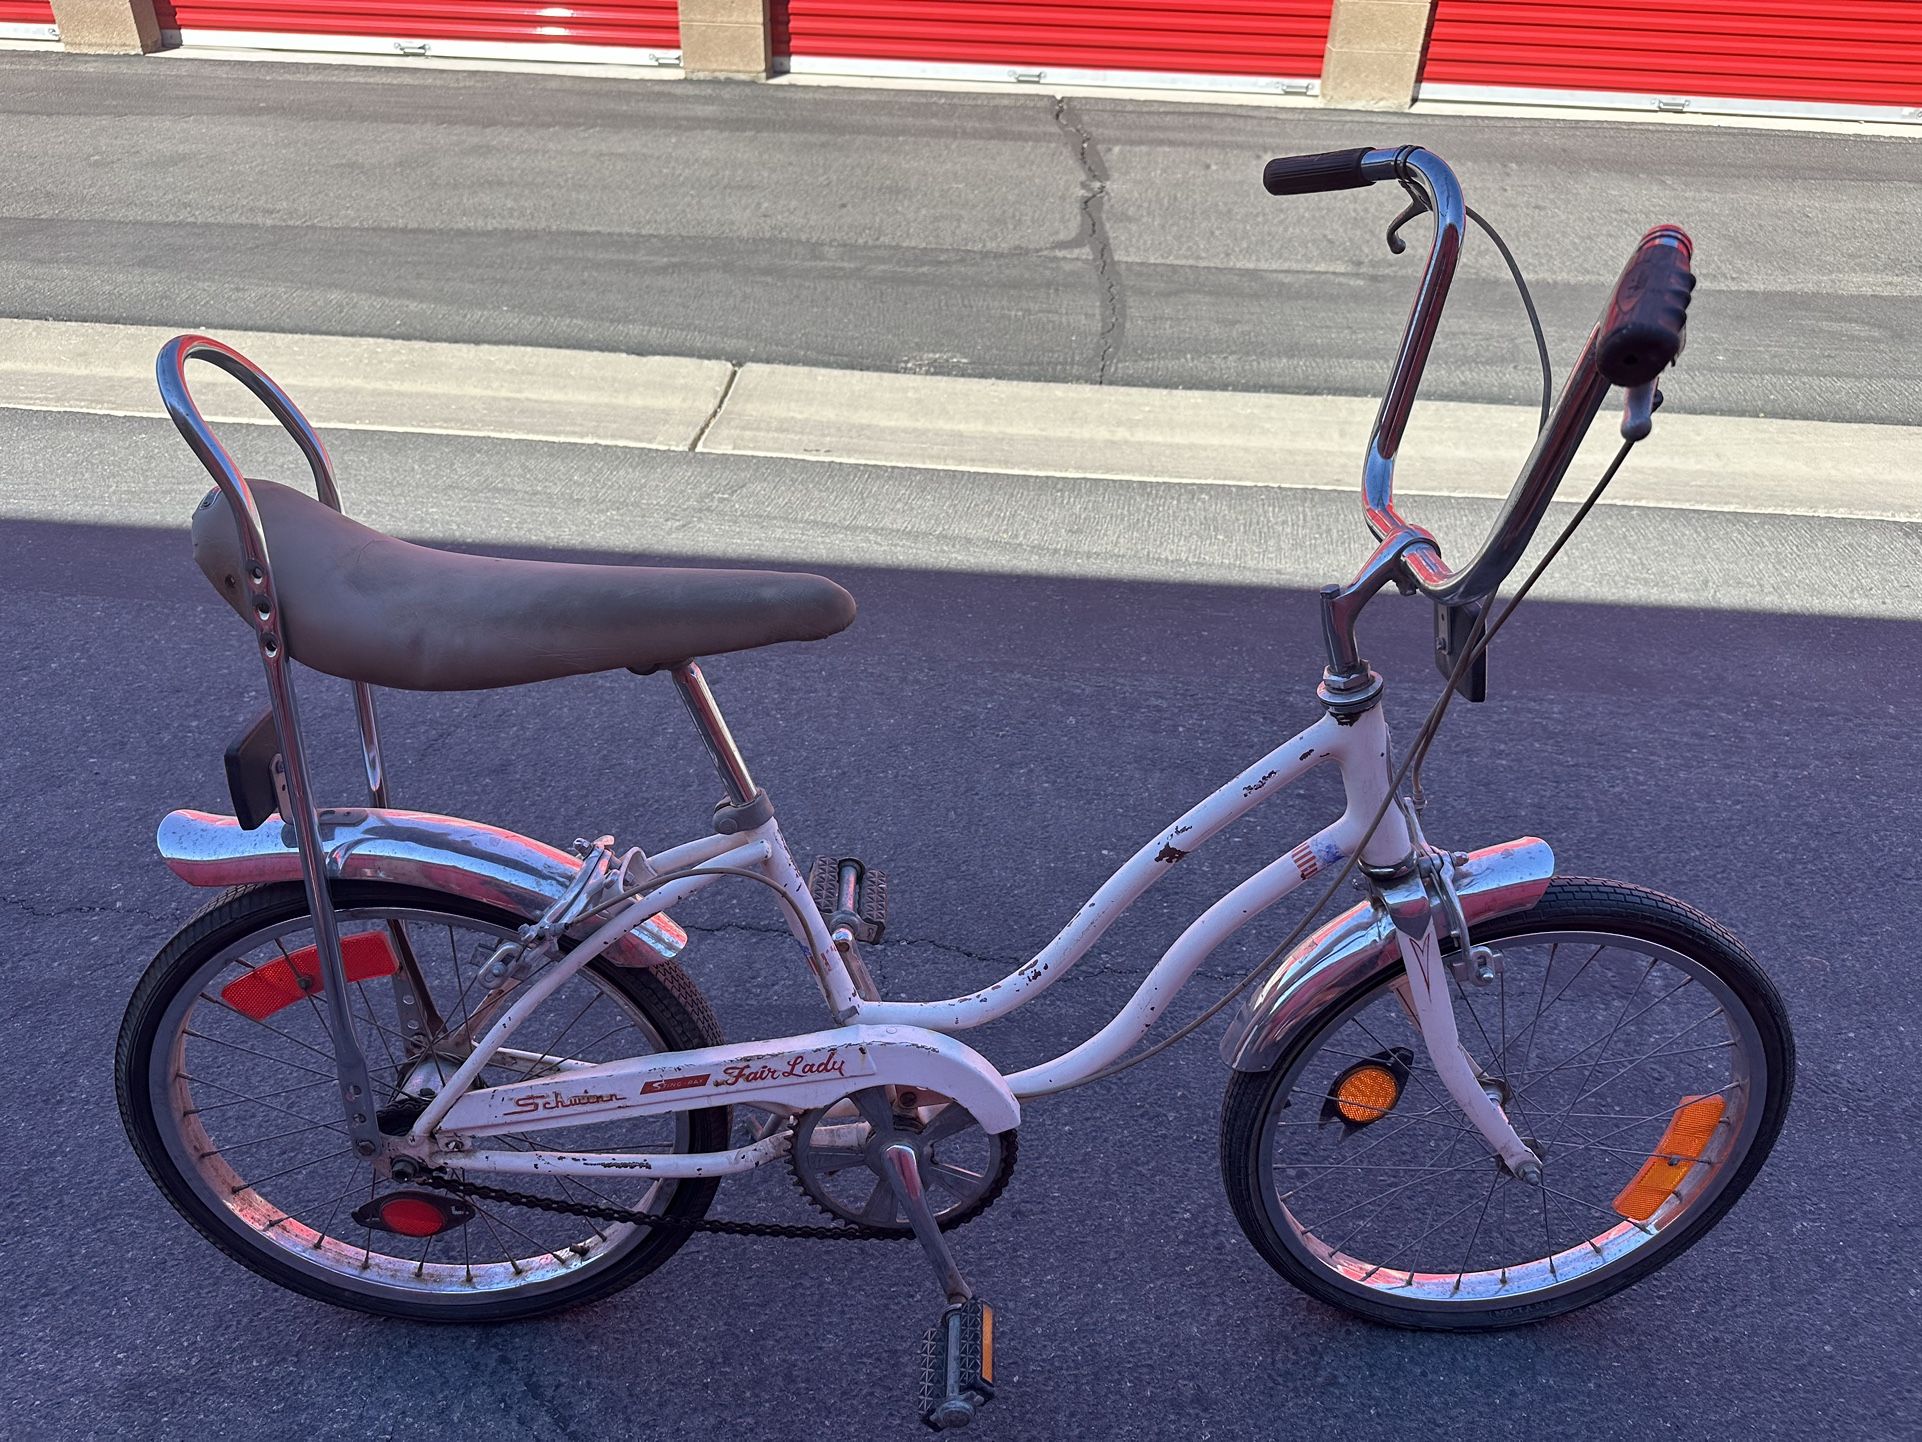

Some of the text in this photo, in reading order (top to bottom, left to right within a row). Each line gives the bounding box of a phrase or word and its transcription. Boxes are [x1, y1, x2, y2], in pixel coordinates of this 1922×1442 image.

[714, 1050, 845, 1087] Fair Lady
[503, 1092, 627, 1116] Schwinn
